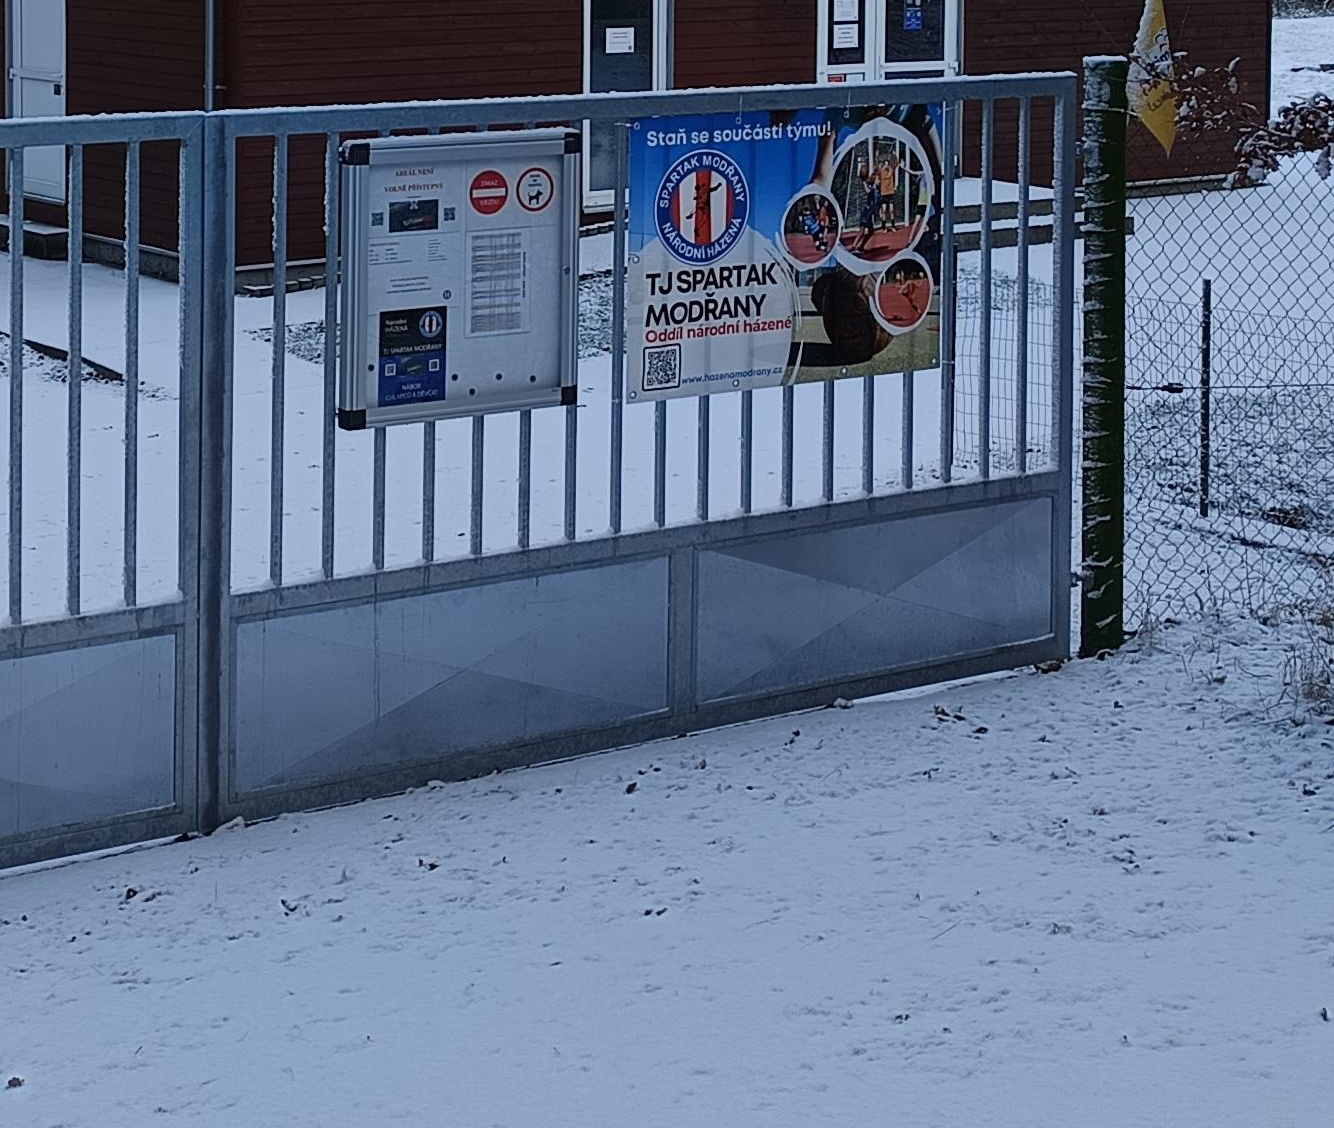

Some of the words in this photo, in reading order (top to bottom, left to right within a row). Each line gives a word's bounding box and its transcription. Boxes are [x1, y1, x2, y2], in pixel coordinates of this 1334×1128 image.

[646, 128, 687, 147] Staň
[690, 131, 710, 144] se
[713, 123, 783, 143] součástí
[786, 120, 832, 142] týmu!
[659, 155, 700, 208] SPARTAK
[702, 154, 746, 202] MODŘANY
[661, 222, 706, 260] NÁRODNÍ
[645, 271, 673, 296] TJ
[676, 262, 778, 294] SPARTAK
[645, 292, 767, 327] MODŘANY
[645, 327, 683, 343] Oddíl
[687, 320, 740, 339] národní
[743, 316, 792, 333] házené
[681, 366, 783, 385] www.hazenamodrany.cz
